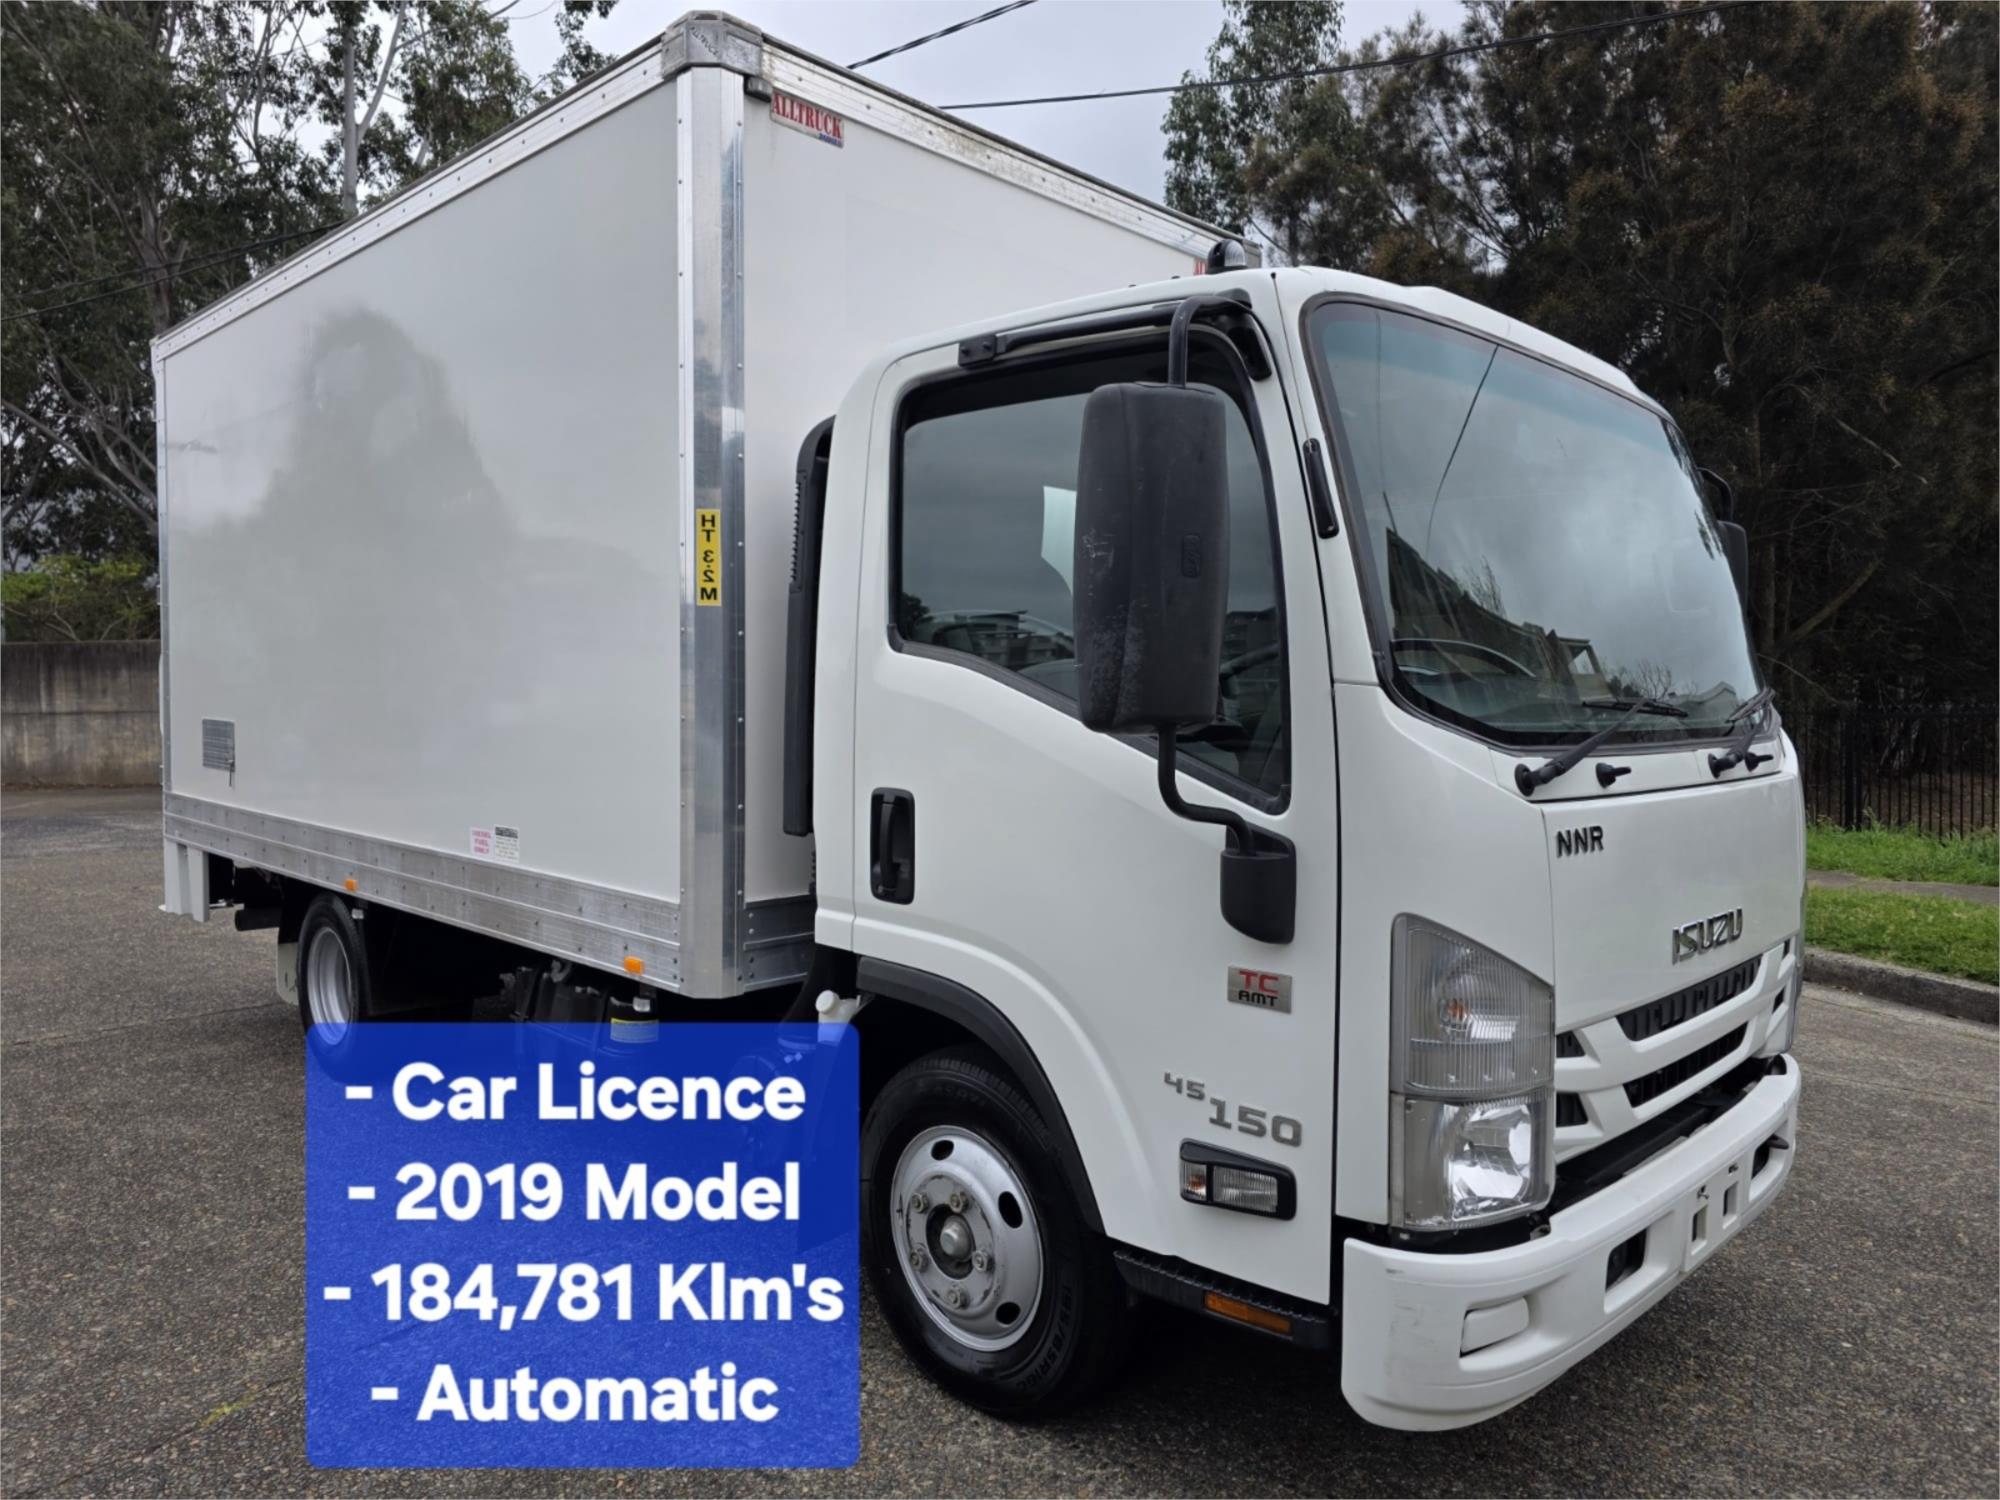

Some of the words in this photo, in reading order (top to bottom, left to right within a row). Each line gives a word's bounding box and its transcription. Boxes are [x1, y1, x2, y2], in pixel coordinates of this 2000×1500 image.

[771, 90, 842, 139] ALLTRUCK
[1556, 825, 1604, 858] NNR
[1672, 908, 1744, 966] ISUZU
[1238, 969, 1279, 994] TC
[1238, 989, 1278, 1007] AMT
[1164, 1072, 1205, 1101] 45
[1209, 1097, 1303, 1148] 150
